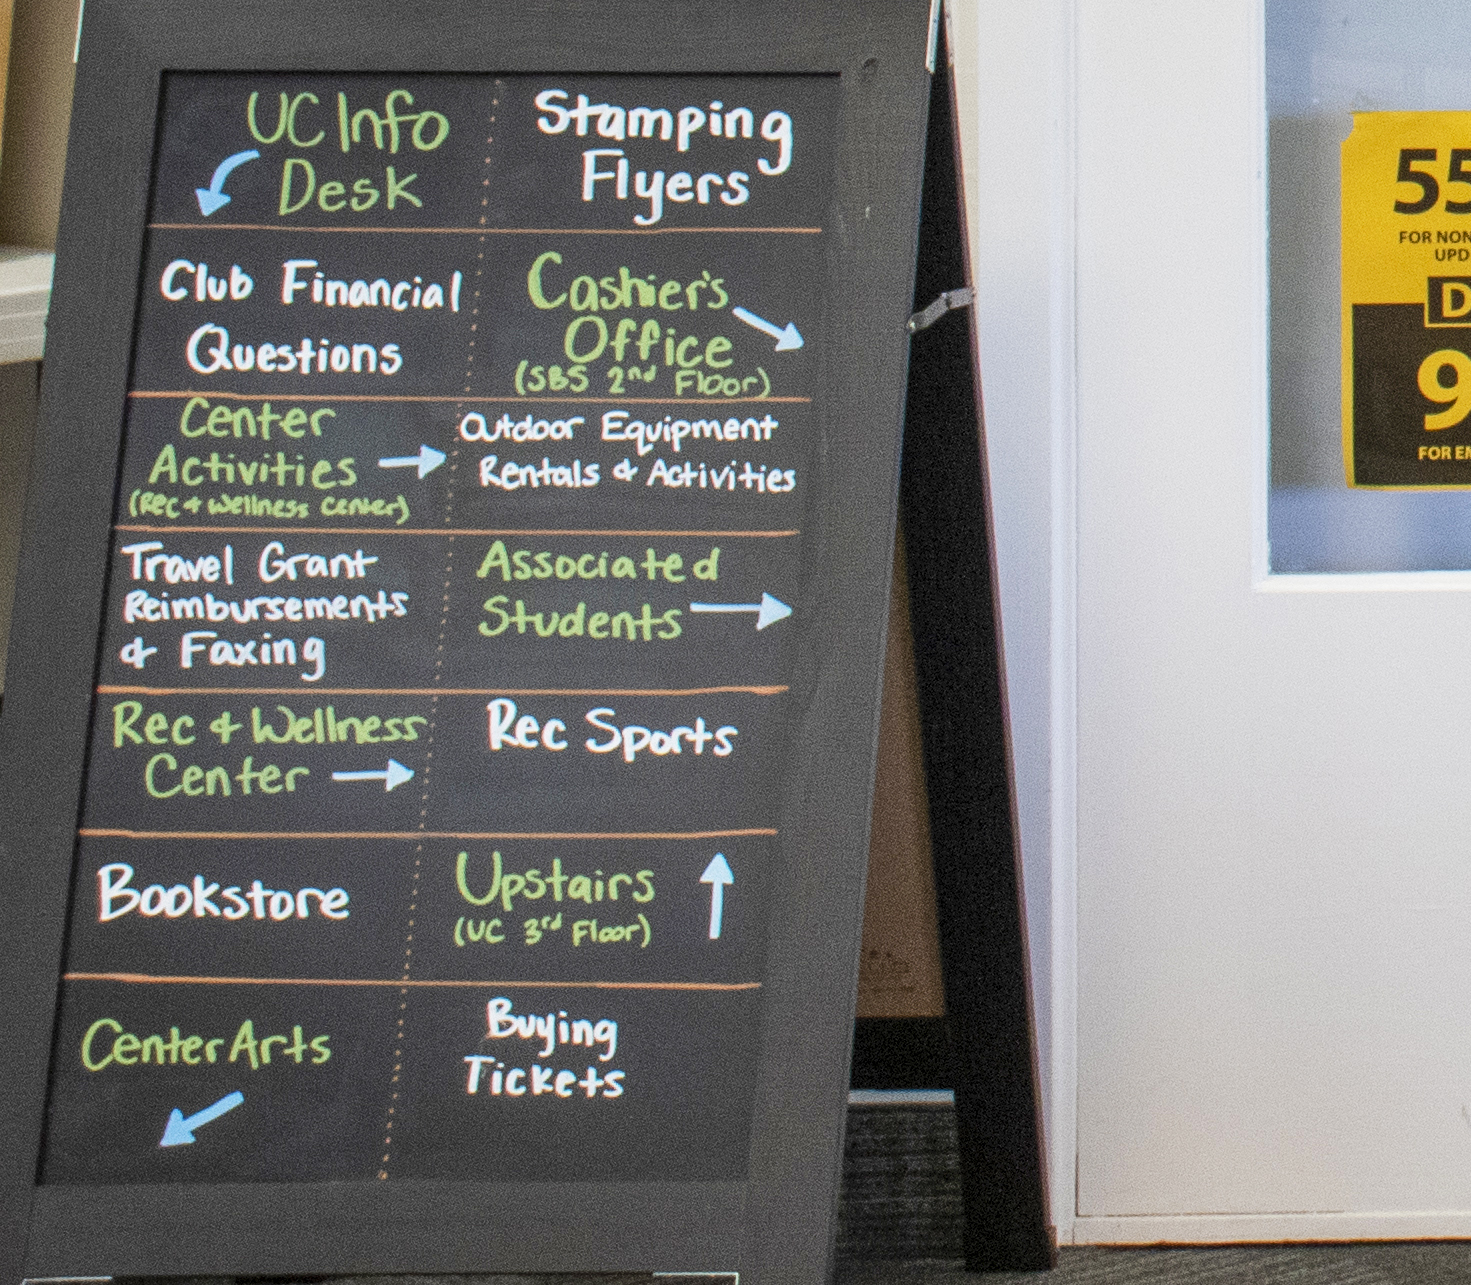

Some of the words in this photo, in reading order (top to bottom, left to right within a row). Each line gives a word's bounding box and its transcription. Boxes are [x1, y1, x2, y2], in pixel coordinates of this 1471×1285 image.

[248, 91, 325, 146] UC
[338, 90, 449, 153] Info
[534, 89, 792, 175] Stamping
[279, 159, 422, 216] Desk
[582, 149, 749, 225] Flyers
[1399, 231, 1432, 244] FOR
[1435, 249, 1470, 262] UPD
[161, 259, 253, 303] Club
[282, 260, 462, 311] Financial
[527, 252, 728, 310] Cashier's
[186, 323, 402, 374] Questions
[564, 315, 733, 367] Office
[515, 360, 589, 396] (SBS
[608, 364, 657, 393] 2nd
[676, 368, 770, 397] Floor)
[180, 396, 336, 441] Center
[460, 411, 585, 443] Outdoor
[601, 410, 778, 456] Equipment
[148, 443, 357, 489] Activities
[479, 455, 600, 490] Rentals
[646, 460, 796, 493] Activities
[1419, 446, 1452, 460] FOR
[120, 541, 233, 584] Travel
[259, 541, 378, 583] Grant
[476, 540, 720, 582] Associated
[125, 589, 409, 623] Reimbursements
[478, 595, 682, 641] Students
[180, 631, 325, 681] Faxing
[113, 700, 195, 747] Rec
[251, 704, 427, 744] Wellness
[487, 698, 568, 751] Rec
[585, 707, 738, 762] Sports
[145, 753, 310, 798] Center
[98, 862, 350, 922] Bookstore
[455, 851, 655, 911] Upstairs
[454, 916, 506, 947] (UC
[524, 913, 562, 945] 3rd
[572, 913, 652, 947] Floor)
[487, 996, 618, 1062] Buying
[464, 1054, 625, 1098] Tickets
